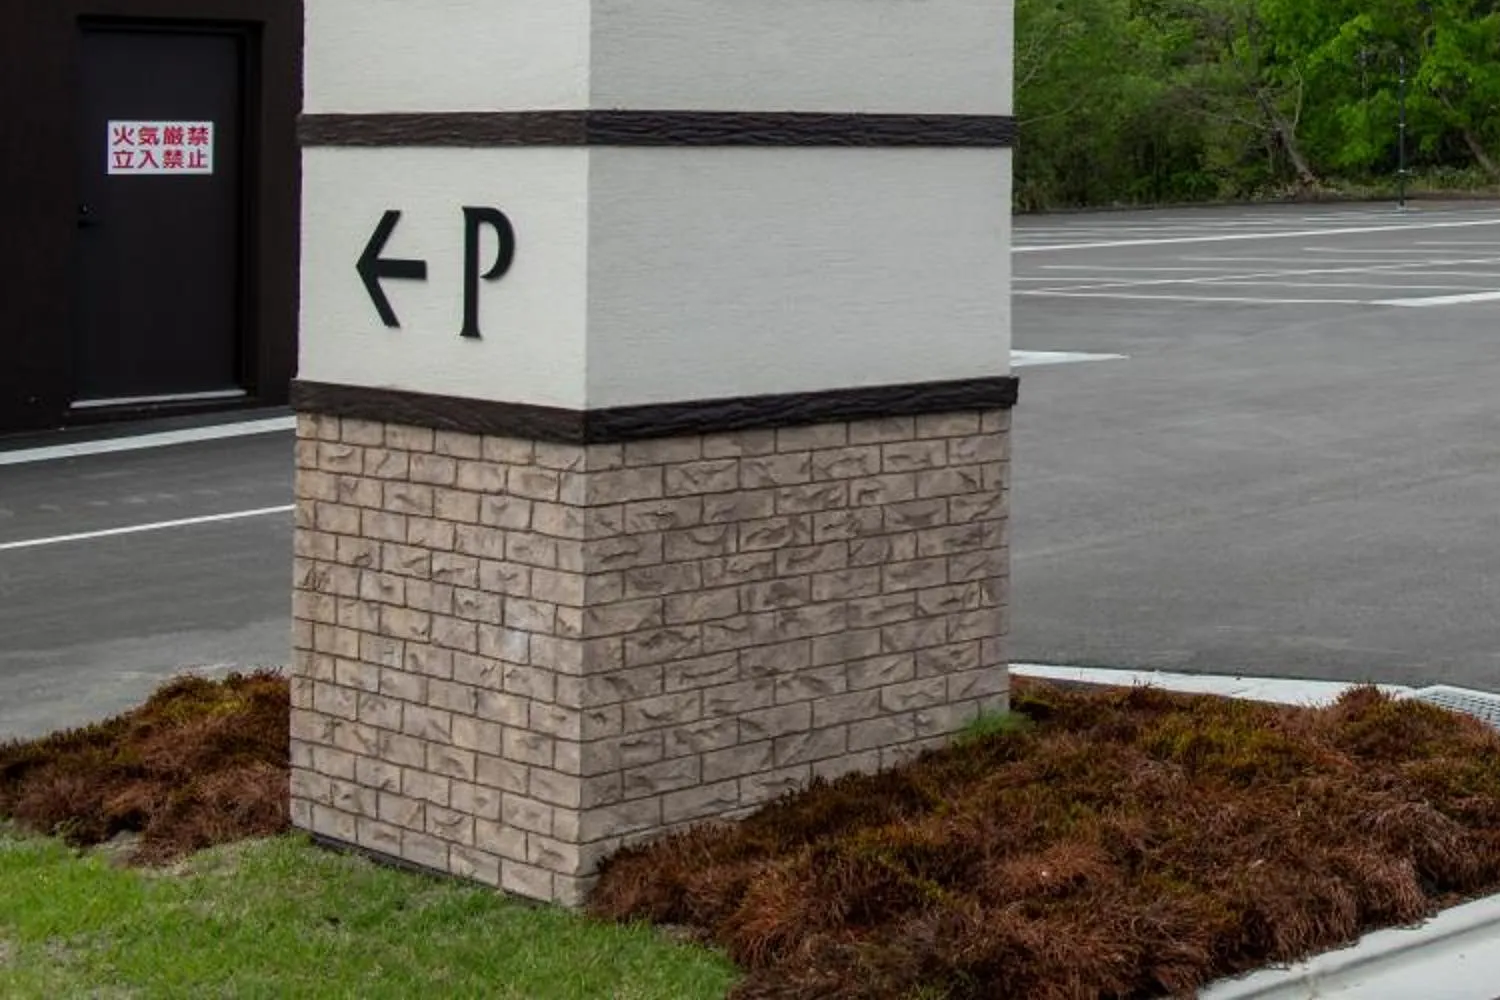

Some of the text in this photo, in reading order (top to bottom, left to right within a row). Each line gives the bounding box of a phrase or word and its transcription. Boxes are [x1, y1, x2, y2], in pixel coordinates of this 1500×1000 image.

[112, 125, 209, 146] 火気厳禁
[112, 148, 209, 169] 立入禁止
[459, 206, 516, 340] P
